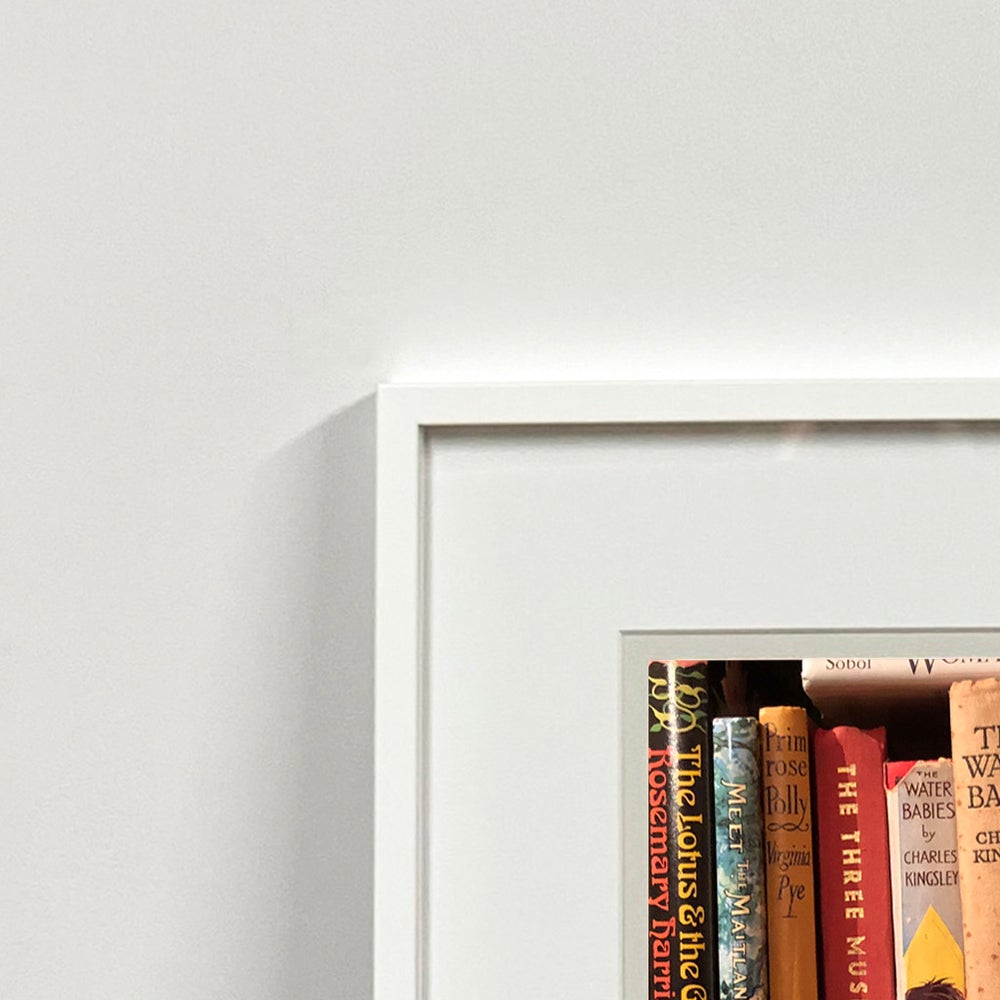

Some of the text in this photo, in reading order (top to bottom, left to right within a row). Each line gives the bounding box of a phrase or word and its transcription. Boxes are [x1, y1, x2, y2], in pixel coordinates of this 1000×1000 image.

[676, 744, 701, 806] The
[766, 757, 808, 778] rose
[916, 771, 938, 779] THE
[837, 763, 859, 816] THE
[905, 781, 952, 798] WATER
[766, 785, 807, 830] Polly
[902, 802, 956, 820] BABIES
[648, 744, 672, 911] Rosemary
[922, 824, 936, 843] by
[677, 813, 703, 899] Lotus
[766, 840, 811, 872] Virginia
[903, 850, 958, 865] CHARLES
[840, 830, 864, 919] THREE
[905, 870, 959, 887] KINGSLEY
[778, 875, 806, 919] Pye
[678, 904, 705, 927] &
[679, 931, 706, 980] the
